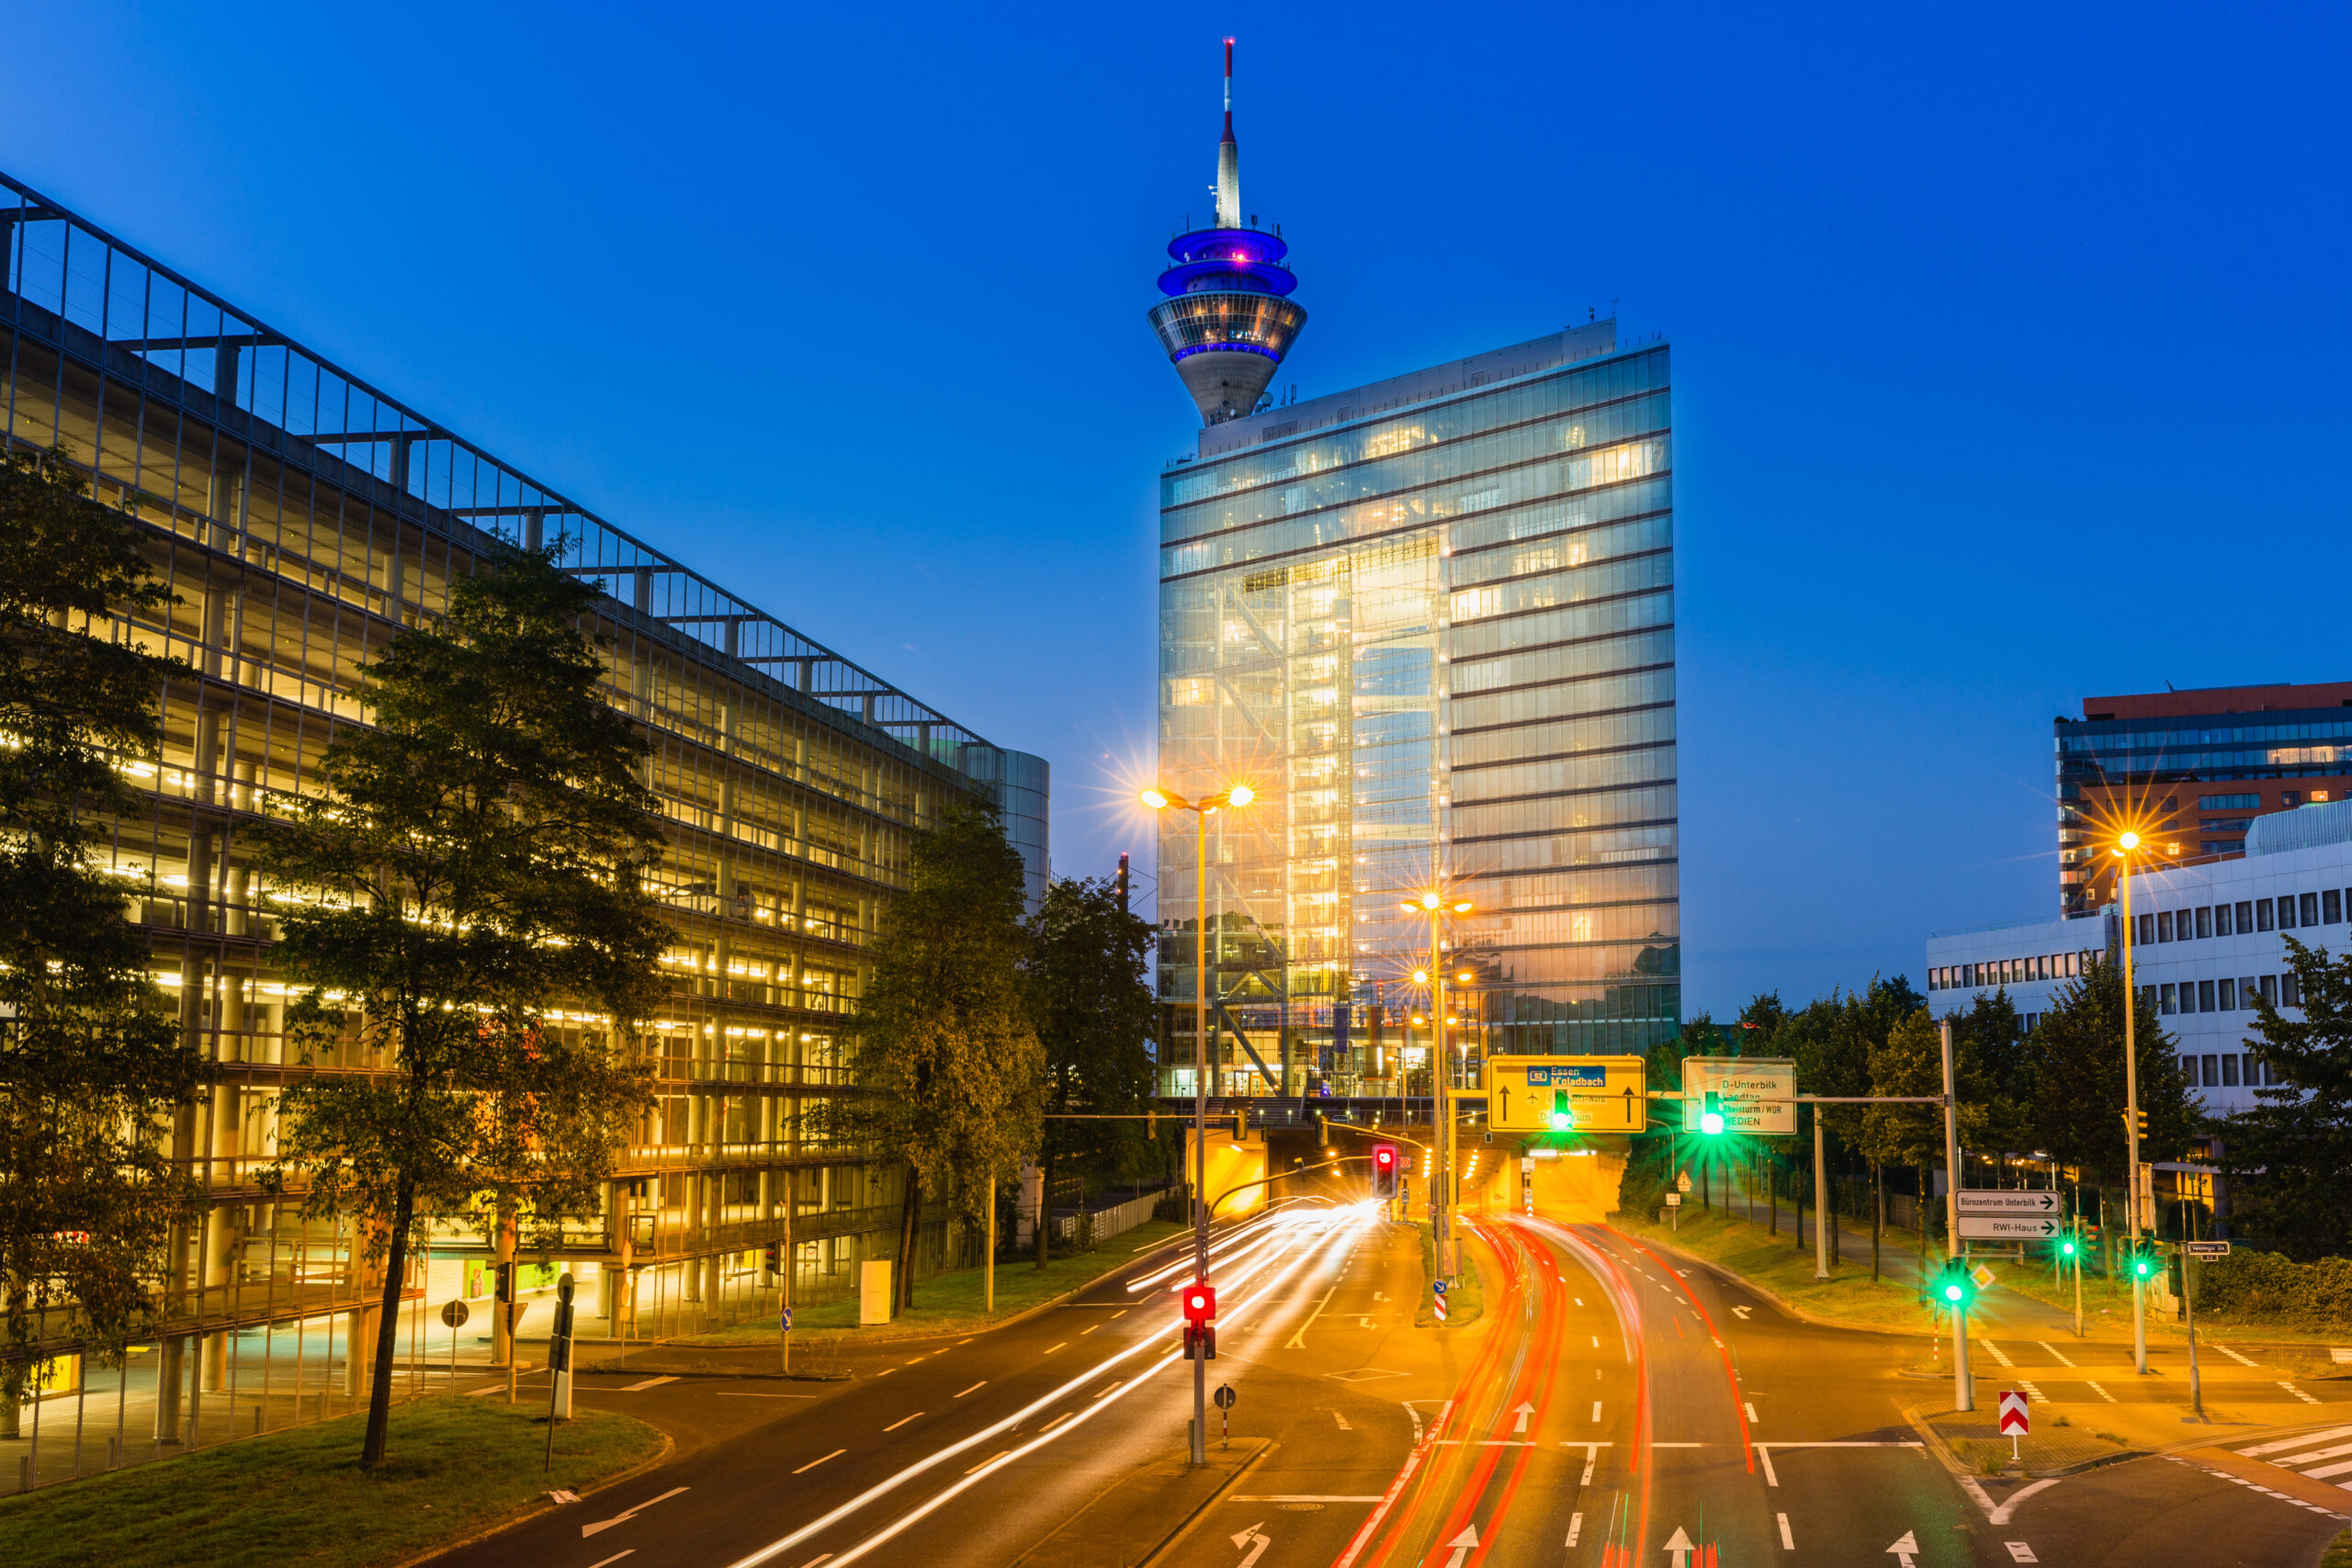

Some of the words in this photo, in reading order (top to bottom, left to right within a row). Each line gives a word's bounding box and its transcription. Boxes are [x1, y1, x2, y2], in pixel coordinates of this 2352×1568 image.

[1551, 1066, 1579, 1076] Essen
[1722, 1080, 1777, 1089] D-Unterbilk
[1961, 1197, 2003, 1206] Bürozentrum
[2005, 1198, 2036, 1206] Unterbilk
[1993, 1223, 2038, 1231] RWI-Haus
